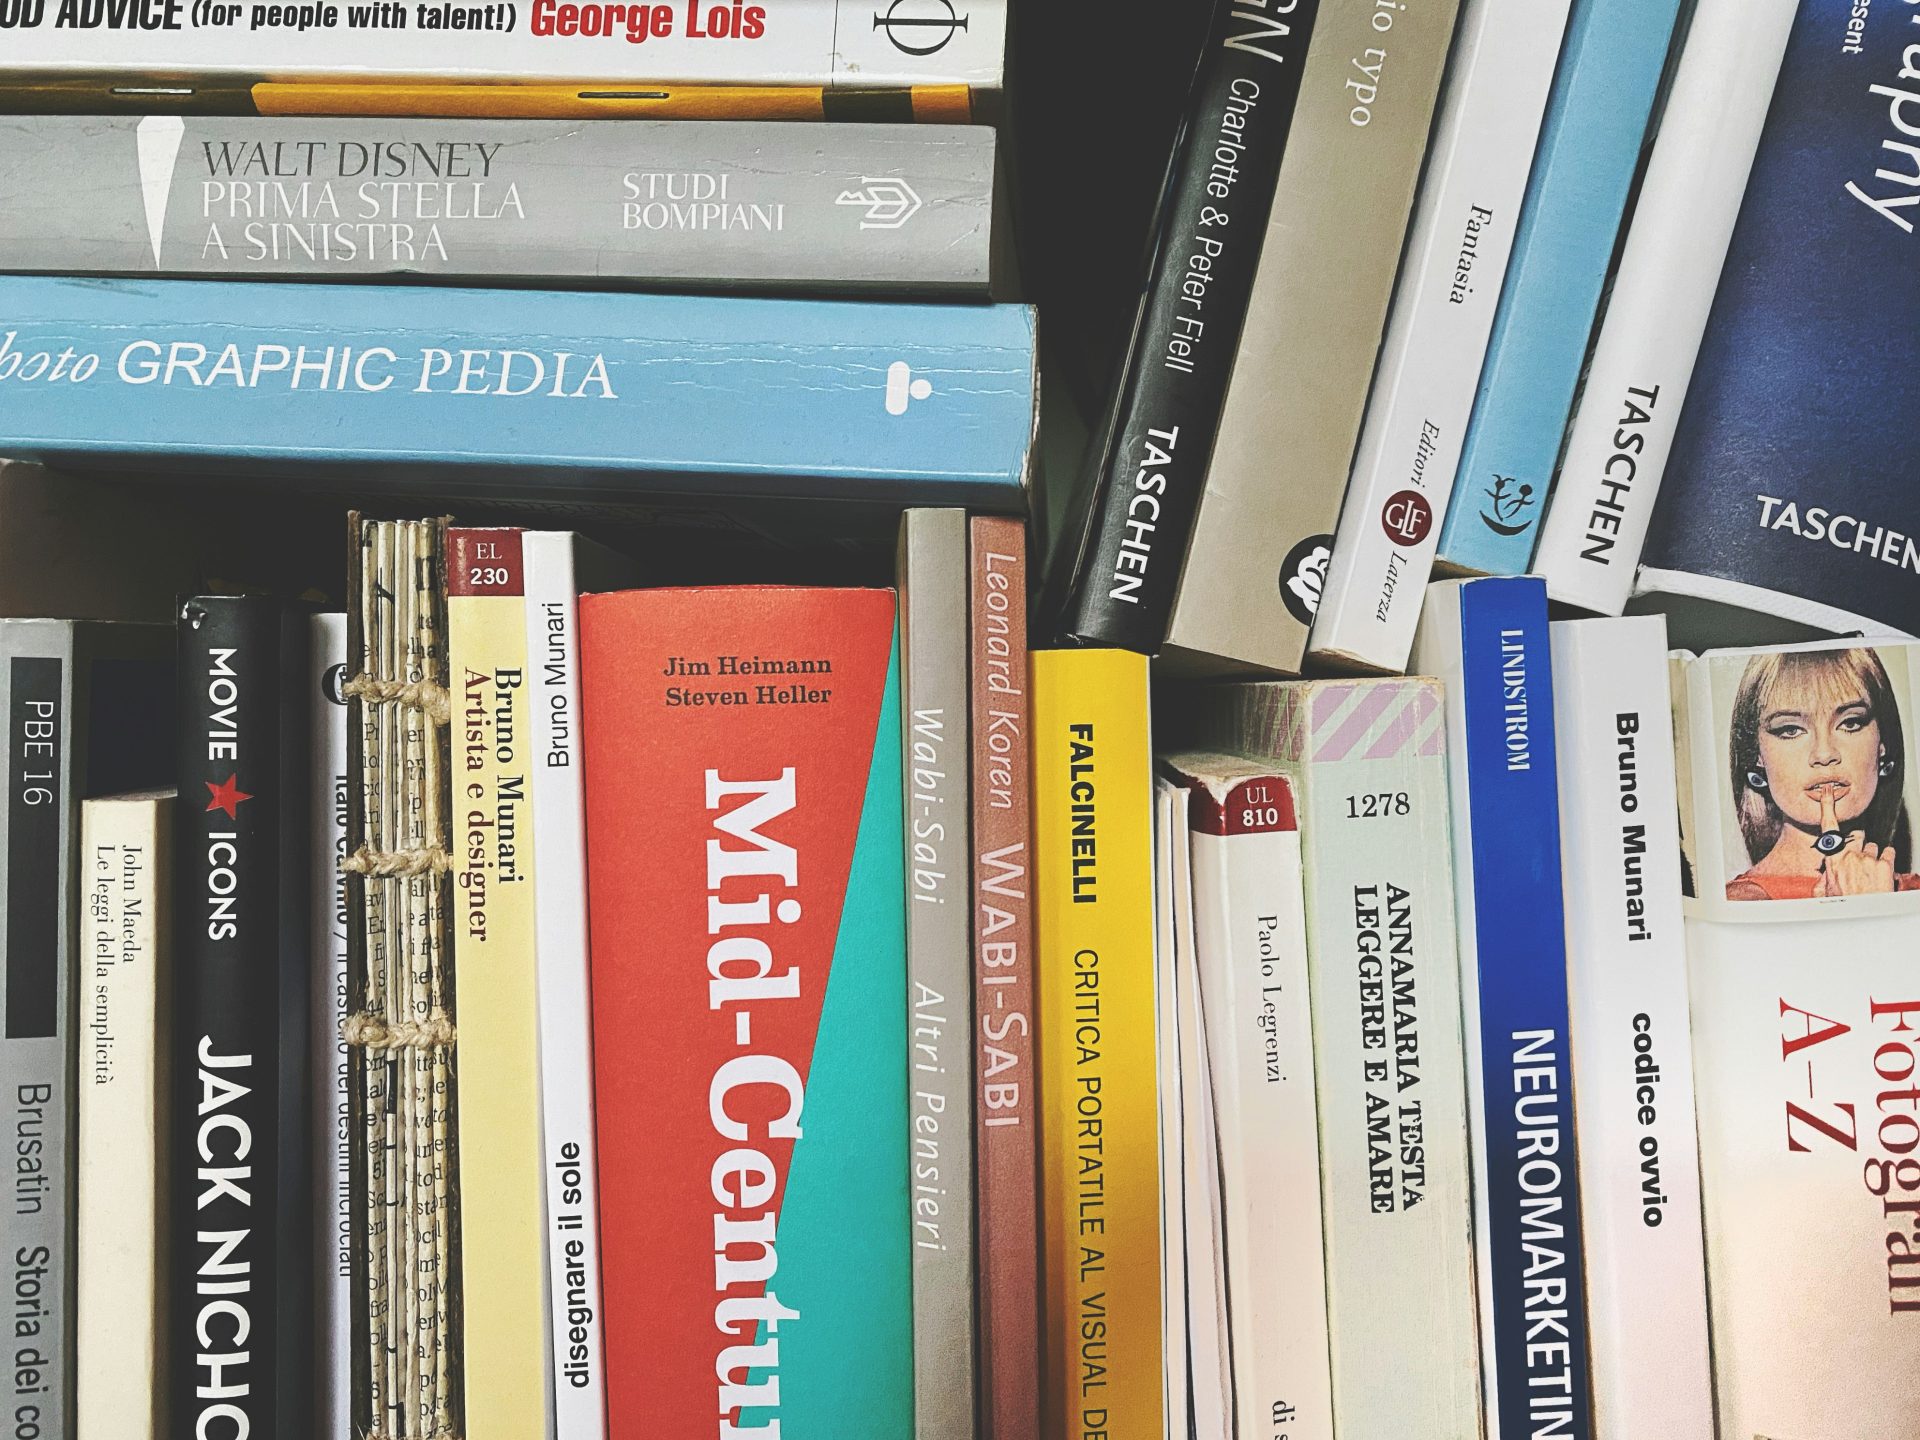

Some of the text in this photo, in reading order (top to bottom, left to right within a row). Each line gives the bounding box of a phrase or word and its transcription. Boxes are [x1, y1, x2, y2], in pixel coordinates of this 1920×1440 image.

[54, 0, 182, 30] ADVICE
[192, 0, 242, 27] (for
[251, 2, 338, 31] people
[348, 1, 406, 29] with
[416, 3, 517, 33] talent!)
[530, 0, 673, 43] George
[686, 0, 766, 39] Lois
[1205, 78, 1260, 199] Charlotte
[1346, 48, 1387, 126] typo
[201, 141, 504, 178] WALT DISNEY
[201, 182, 526, 219] PRIMA STELLA
[622, 173, 728, 200] STUDI
[201, 222, 448, 261] A SINISTRA
[622, 202, 784, 230] BOMPIANI
[1199, 205, 1229, 227] &
[1448, 203, 1493, 305] Fantasia
[1180, 236, 1222, 310] Peter
[116, 340, 396, 391] GRAPHIC
[412, 349, 618, 399] PEDIA
[1164, 313, 1204, 373] Fiell
[1411, 418, 1440, 488] Editori
[1580, 384, 1659, 565] TASCHEN
[475, 543, 502, 560] EL
[1108, 426, 1178, 603] TASCHEN
[1757, 494, 1920, 575] TASCHEN
[470, 568, 509, 585] 230
[1376, 550, 1407, 623] Laterza
[544, 603, 569, 767] Bruno Munari
[663, 656, 832, 677] Jim Heimann
[665, 685, 831, 706] Steven Heller
[985, 551, 1024, 808] Leonard Koren
[1500, 630, 1531, 771] LINDSTROM
[23, 701, 54, 805] PBE 16
[208, 648, 238, 941] MOVIE ICONS
[459, 668, 493, 942] Artista e designer
[495, 666, 524, 883] Bruno Munari
[913, 707, 945, 904] Wabi-Sabi
[1246, 787, 1273, 804] UL
[1346, 793, 1411, 819] 1278
[1069, 724, 1097, 904] FALCINELLI
[1242, 808, 1278, 826] 810
[1615, 712, 1652, 942] Bruno Munari
[122, 845, 142, 963] John Maeda
[90, 845, 115, 1085] Le leggi della semplicità
[980, 842, 1028, 1126] WABI-SABI
[1074, 949, 1101, 1066] CRITICA
[1257, 914, 1287, 1083] Paolo Legrenzi
[1354, 884, 1394, 1214] LEGGERE E AMARE
[1386, 883, 1426, 1212] ANNAMARIA TESTA
[915, 981, 947, 1251] Altri Pensieri
[1077, 1077, 1104, 1235] PORTATILE
[1632, 1012, 1667, 1228] codice ovvio
[15, 1083, 51, 1440] Brusatin Storia dei co
[196, 1034, 252, 1440] JACK NICHO
[555, 1142, 593, 1388] disegnare il sole
[1080, 1247, 1105, 1283] AL
[1511, 1029, 1575, 1440] NEUROMARKETIN
[1081, 1292, 1107, 1397] VISUAL
[1272, 1400, 1295, 1426] di
